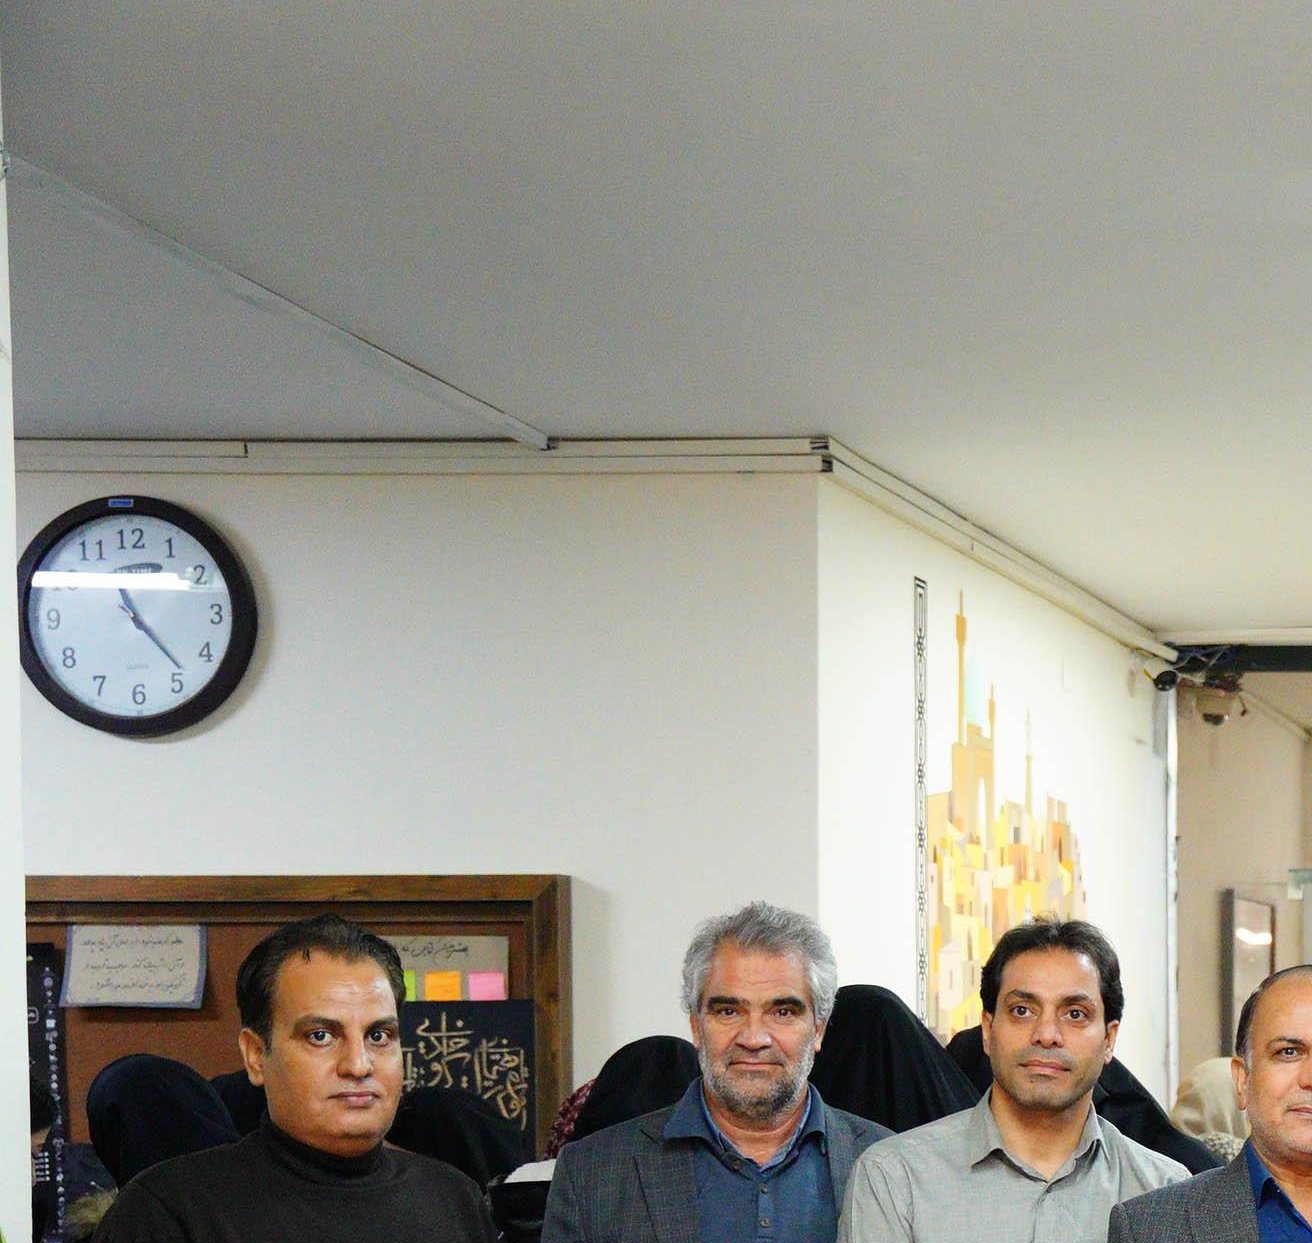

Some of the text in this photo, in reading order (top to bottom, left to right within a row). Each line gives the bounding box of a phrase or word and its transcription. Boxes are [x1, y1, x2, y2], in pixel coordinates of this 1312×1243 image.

[117, 528, 145, 550] 12
[165, 538, 176, 559] 1
[79, 540, 106, 561] 11
[193, 565, 209, 585] 2
[47, 609, 61, 631] 9
[210, 604, 224, 625] 3
[62, 647, 77, 669] 8
[199, 642, 213, 663] 4
[93, 675, 107, 697] 7
[171, 672, 184, 694] 5
[132, 684, 147, 706] 6
